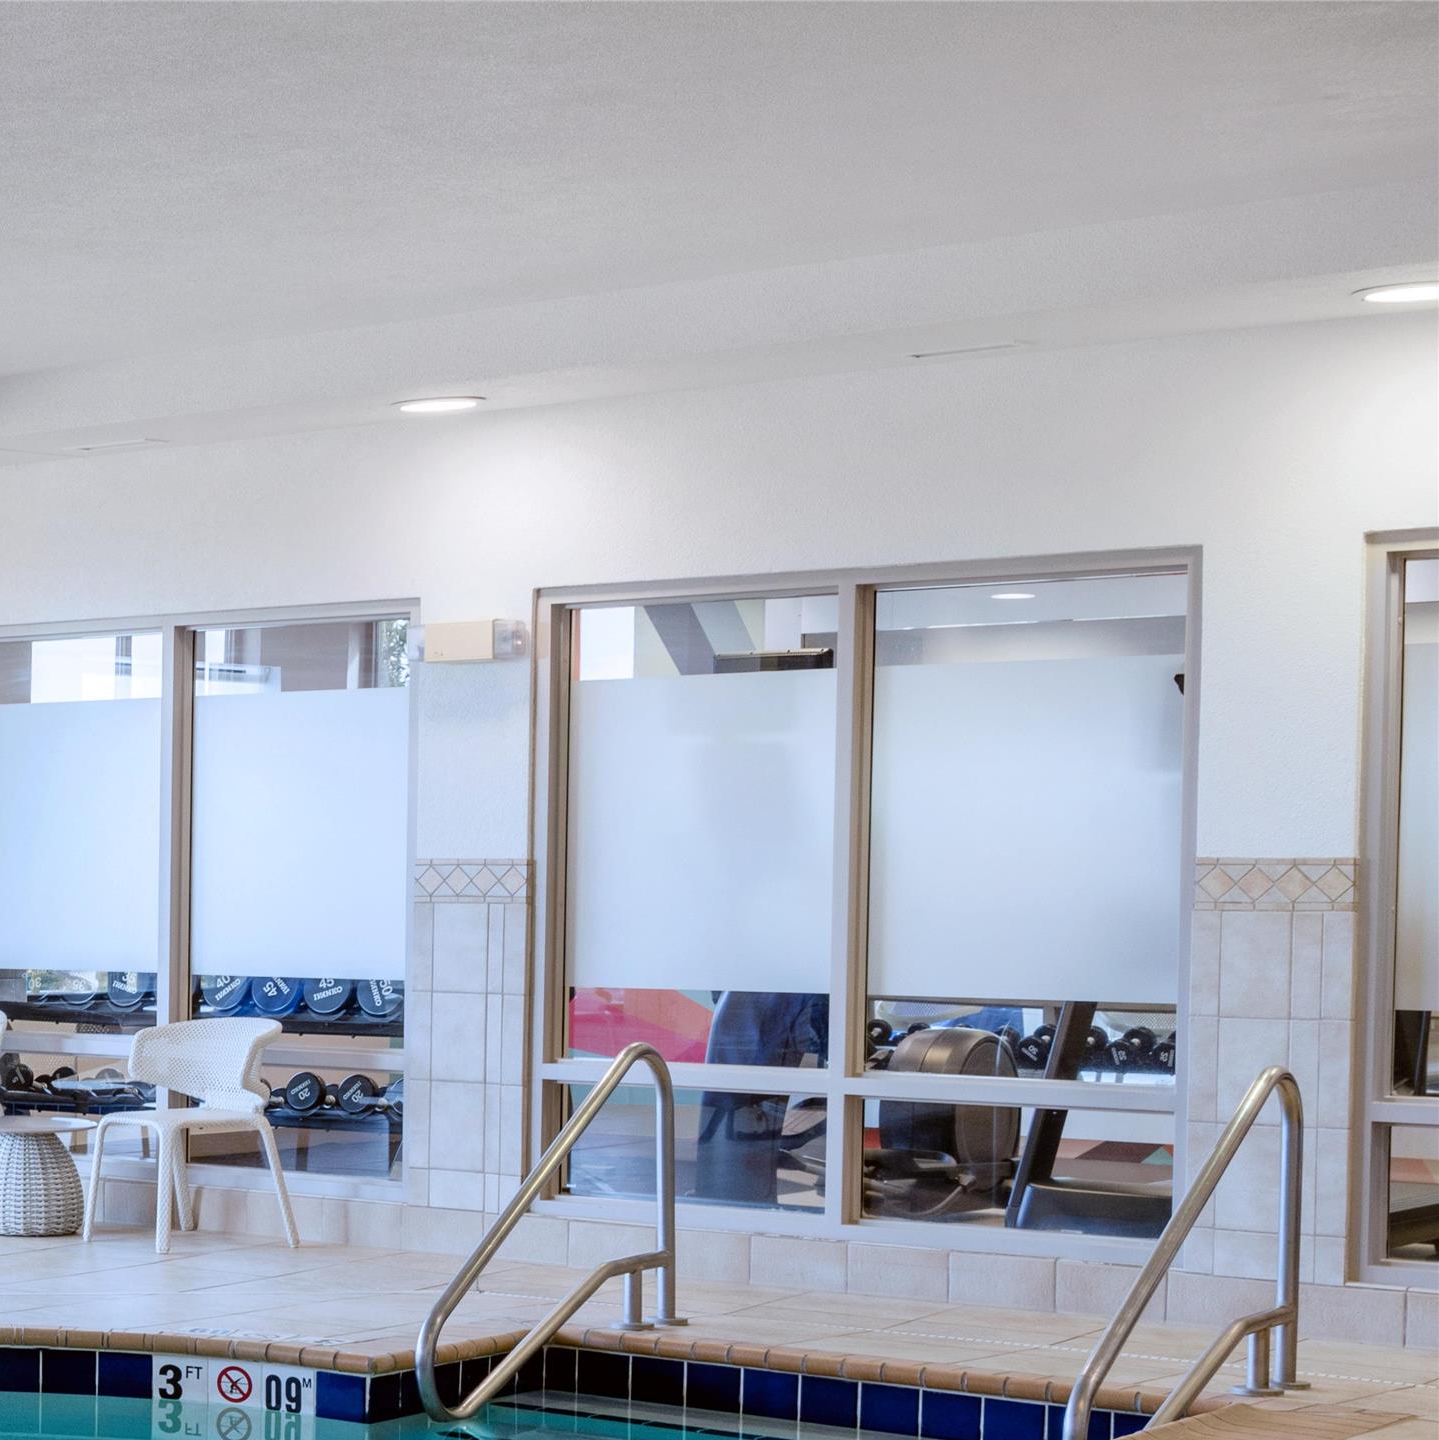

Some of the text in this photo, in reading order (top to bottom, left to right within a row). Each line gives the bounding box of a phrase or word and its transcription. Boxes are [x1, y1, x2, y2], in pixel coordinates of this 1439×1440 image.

[298, 1088, 310, 1100] 20
[159, 1364, 202, 1400] 3 FT
